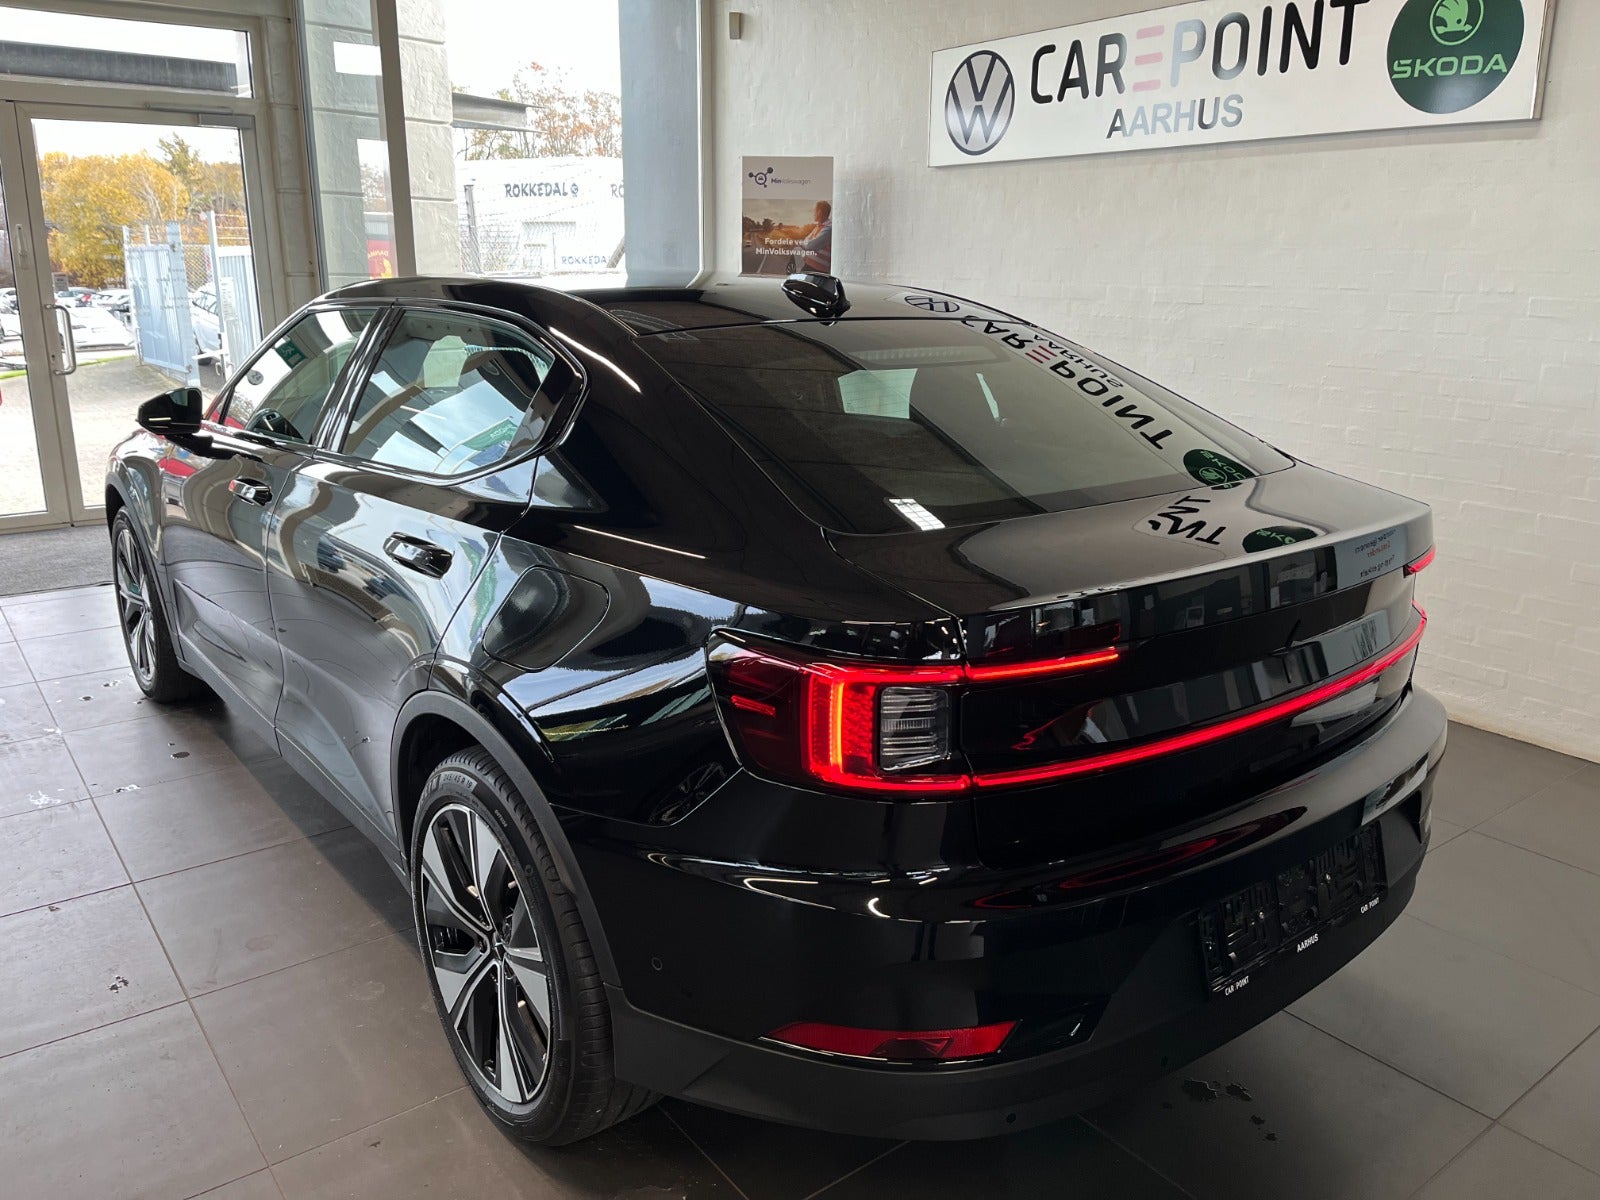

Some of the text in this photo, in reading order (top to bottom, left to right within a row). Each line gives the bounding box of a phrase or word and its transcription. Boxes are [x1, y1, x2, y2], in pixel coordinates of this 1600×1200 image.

[1106, 94, 1244, 139] AARHUS
[504, 182, 568, 198] ROKKEDAL
[764, 237, 794, 246] Fordele
[561, 255, 610, 265] ROKKEDA
[1296, 933, 1319, 953] AARHUS
